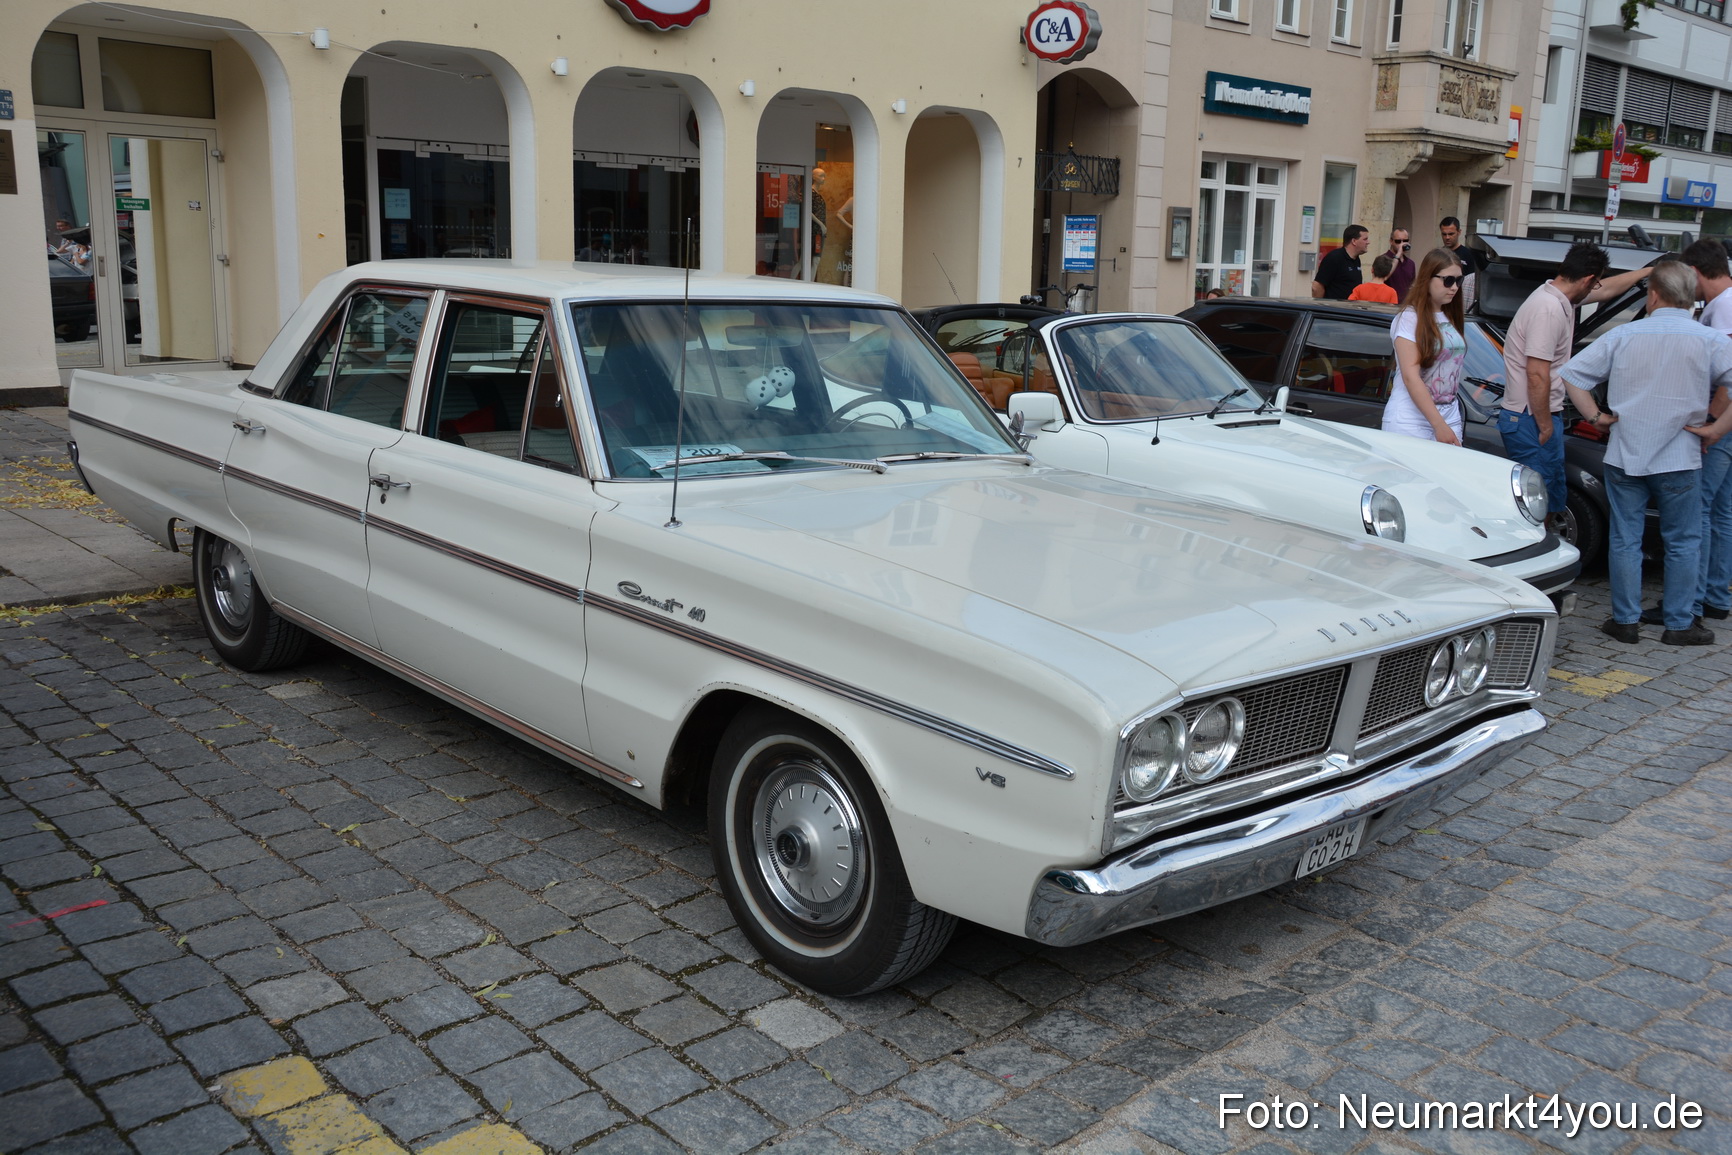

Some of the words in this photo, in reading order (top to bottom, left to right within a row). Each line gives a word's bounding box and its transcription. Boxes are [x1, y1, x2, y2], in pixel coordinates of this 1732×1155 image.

[1035, 16, 1076, 43] C&A
[1018, 157, 1022, 168] 7
[975, 766, 1006, 788] V8
